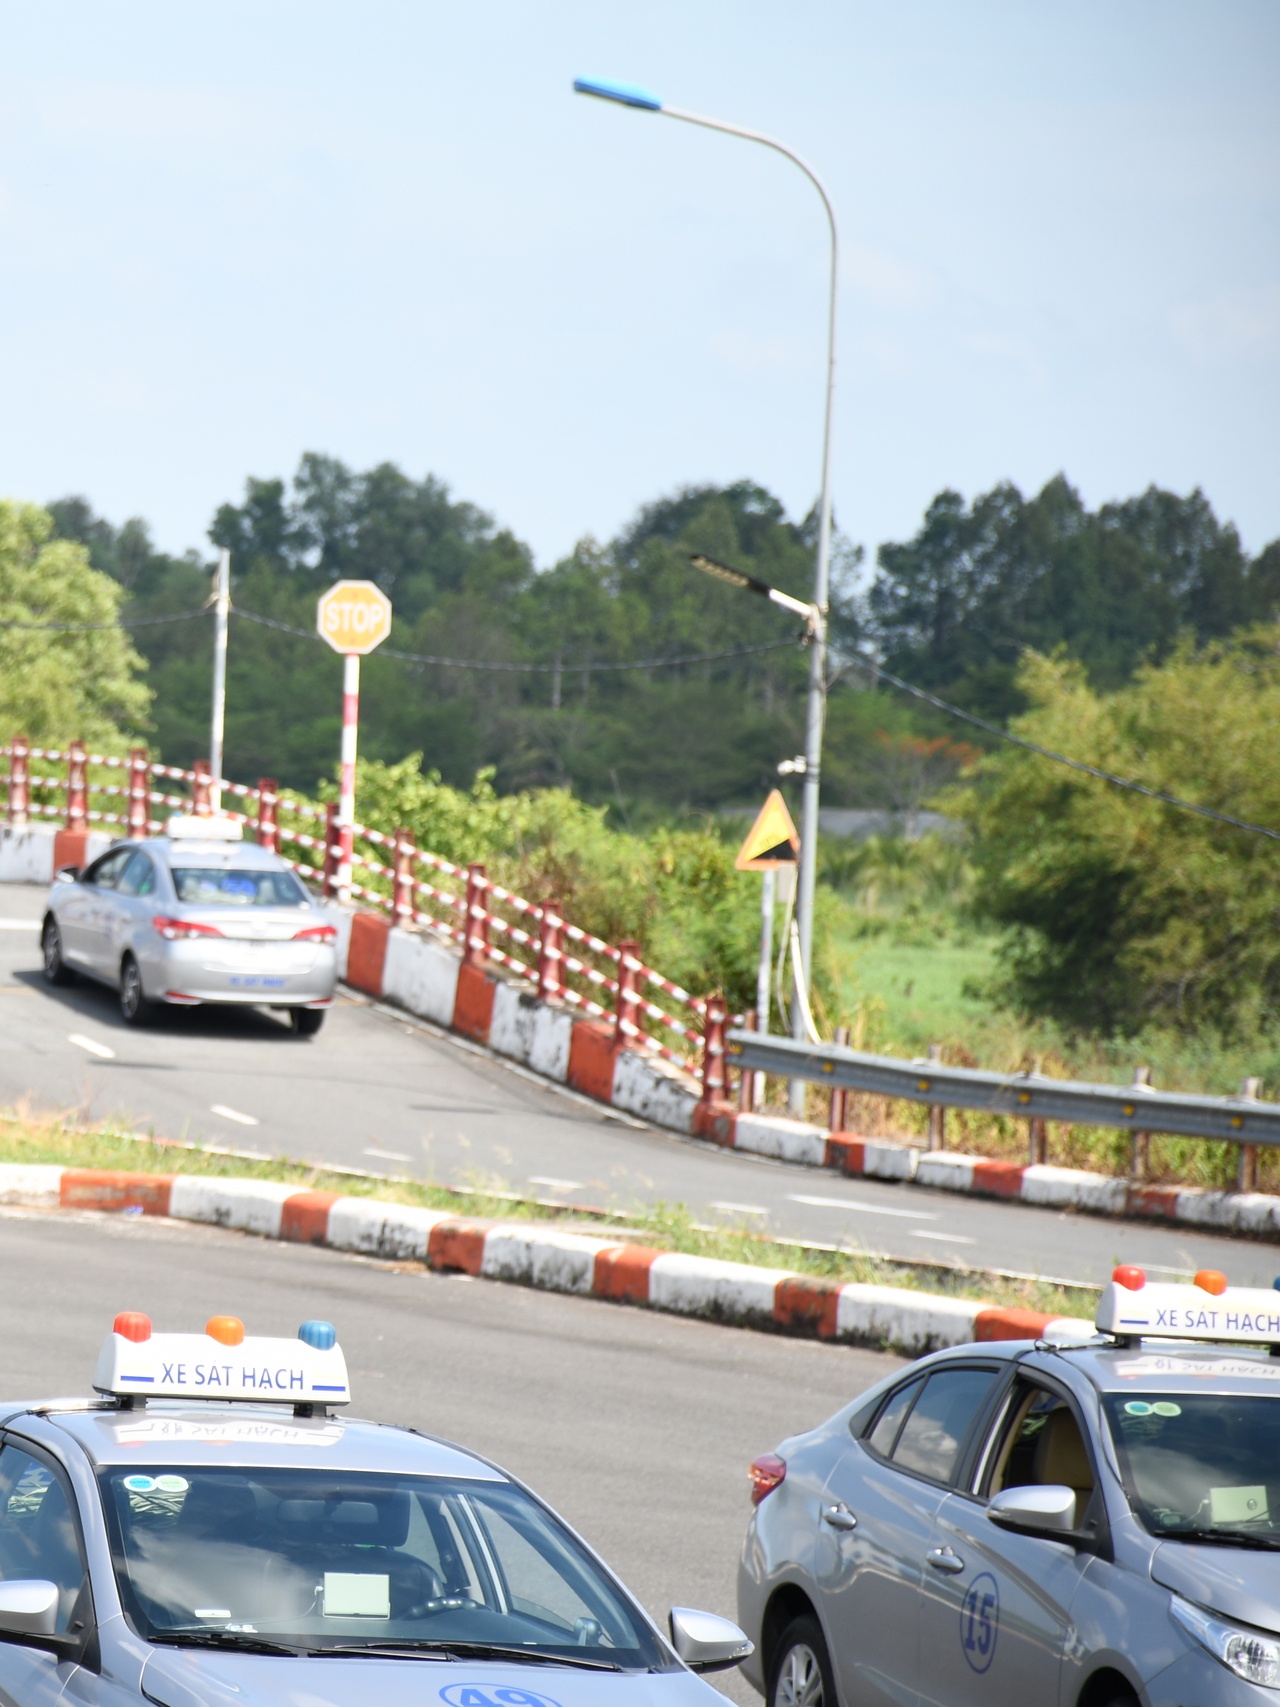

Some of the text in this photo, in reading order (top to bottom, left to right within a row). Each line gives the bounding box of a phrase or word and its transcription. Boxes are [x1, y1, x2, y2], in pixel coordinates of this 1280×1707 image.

[326, 602, 384, 634] STOP
[1156, 1305, 1280, 1333] XE SÁT HẠCH
[161, 1360, 304, 1390] XE SÁT HẠCH
[965, 1590, 995, 1656] 15
